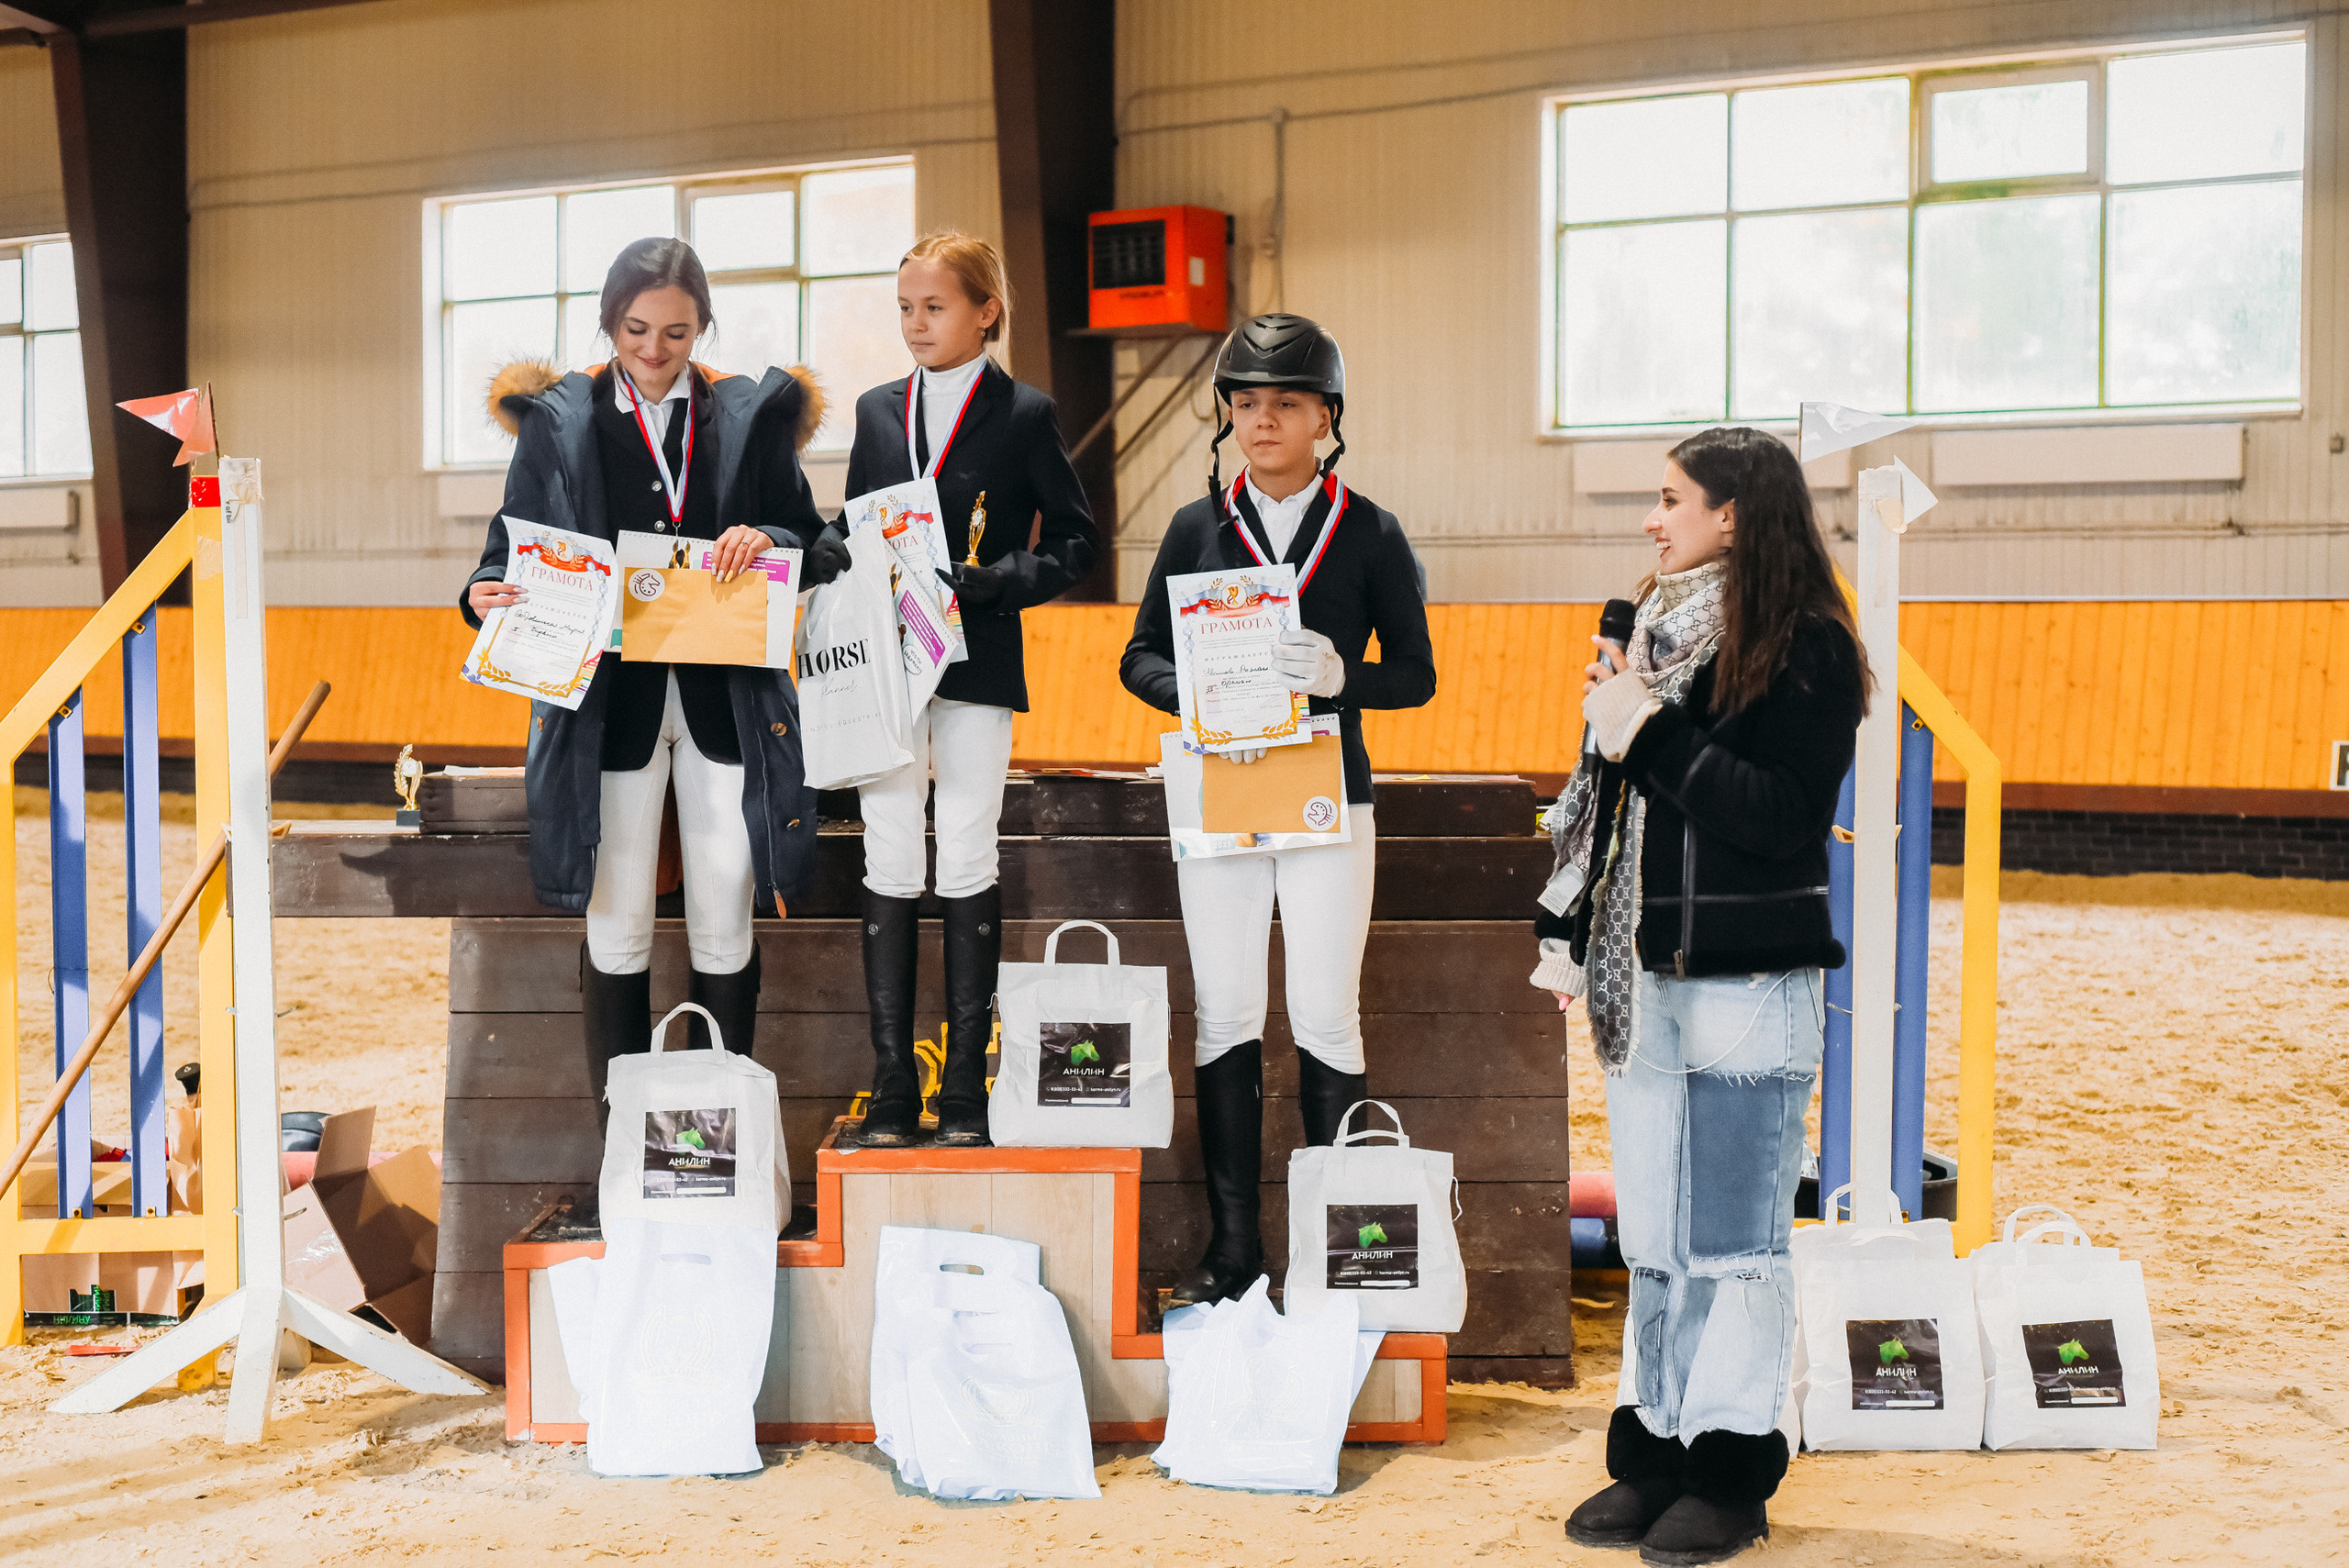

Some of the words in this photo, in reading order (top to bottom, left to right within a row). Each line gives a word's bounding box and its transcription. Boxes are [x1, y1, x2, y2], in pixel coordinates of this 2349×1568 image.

[531, 566, 593, 591] ГРАМОТА
[1201, 617, 1273, 634] ГРАМОТА
[797, 639, 871, 679] HORSE
[1205, 652, 1268, 662] НАГРАЖДАЕТС
[1063, 1068, 1105, 1076] АНИЛИН
[668, 1157, 710, 1166] АНИЛИН
[1352, 1251, 1393, 1260] АНИЛИН
[1876, 1367, 1917, 1376] АНИЛИН
[2058, 1365, 2099, 1375] АНИЛИН
